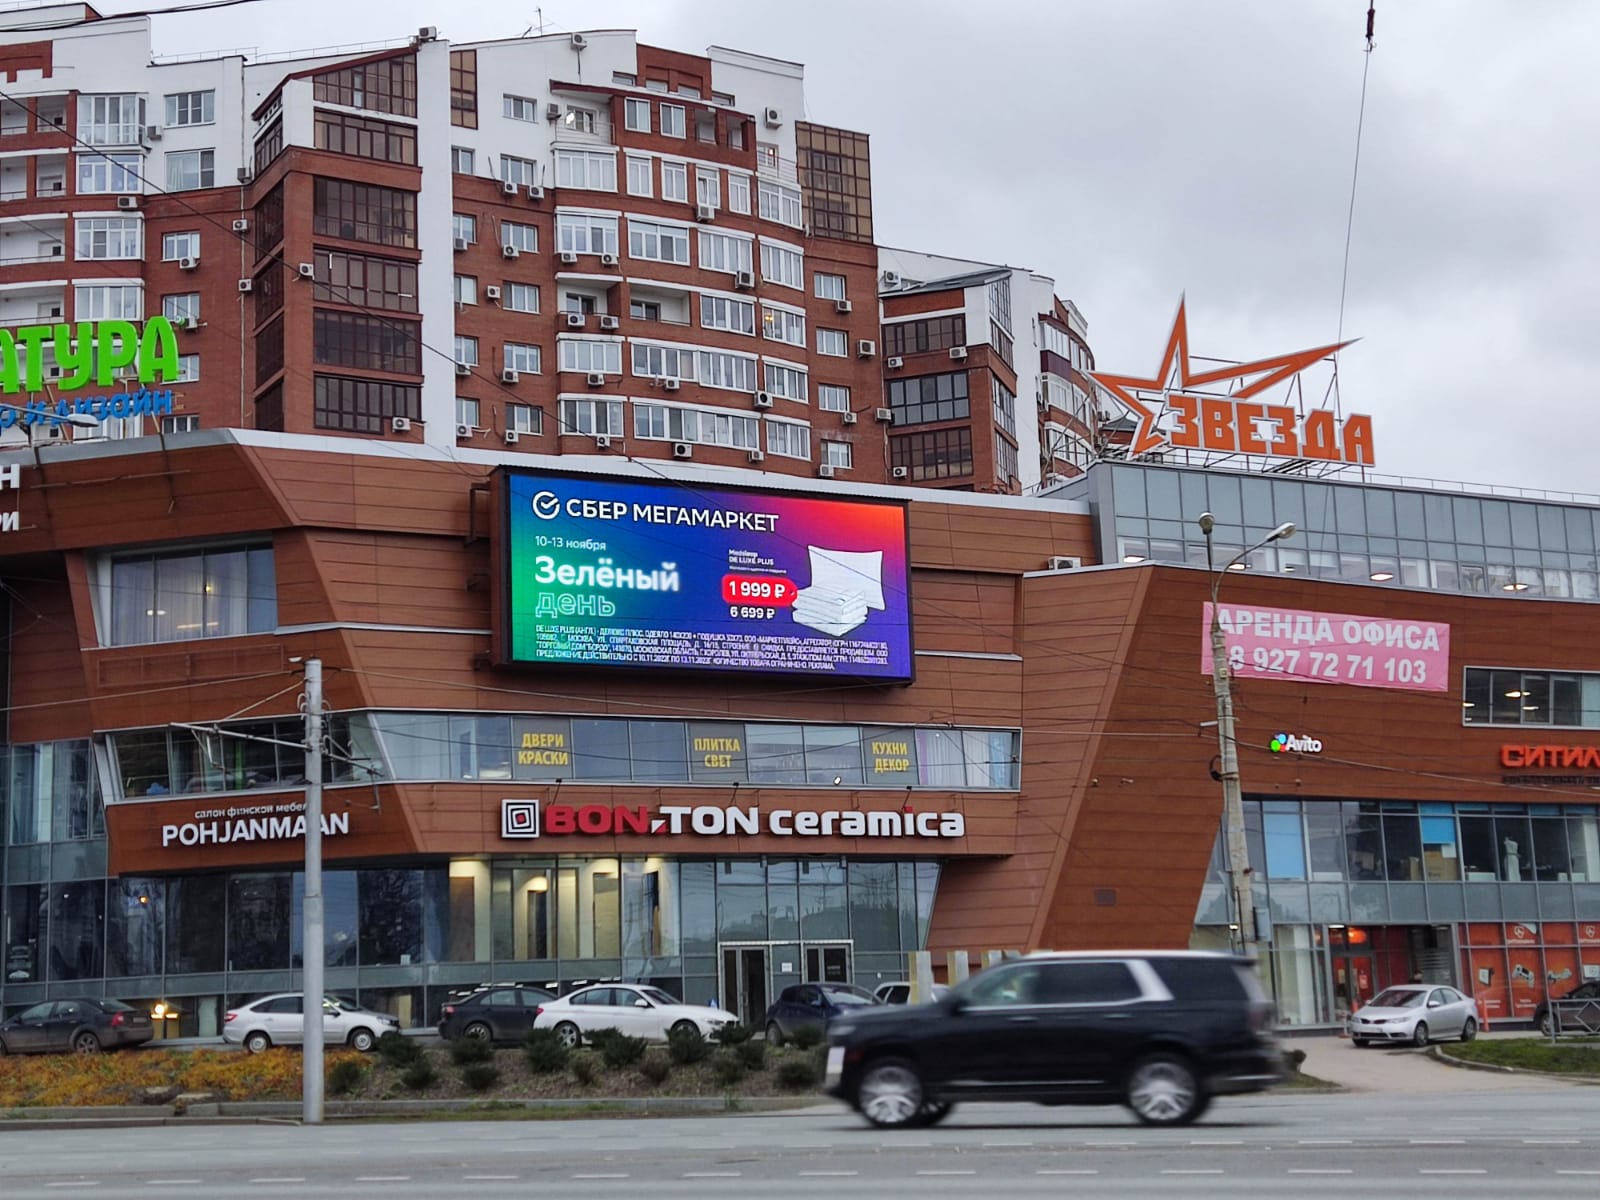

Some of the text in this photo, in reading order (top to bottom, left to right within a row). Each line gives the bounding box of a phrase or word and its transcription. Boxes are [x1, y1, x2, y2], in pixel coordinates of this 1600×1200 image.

[1165, 394, 1375, 467] ЗВЕЗДА
[0, 511, 19, 532] и
[566, 498, 779, 532] СБЕР МЕГАМАРКЕТ
[535, 535, 606, 551] 10-13 ноября
[739, 556, 756, 565] LUXE
[757, 558, 774, 566] PLUS
[535, 555, 680, 592] Зелёный
[729, 580, 736, 596] 1
[740, 581, 771, 598] 999
[535, 592, 616, 618] день
[730, 606, 738, 617] 6
[741, 607, 764, 618] 699
[1218, 608, 1440, 651] АРЕНДА ОФИСА
[1229, 645, 1427, 683] 8 927 72 71 103
[522, 733, 564, 749] ДВЕРИ
[694, 738, 740, 753] ПЛИТКА
[872, 742, 908, 756] КУХНИ
[1285, 734, 1322, 752] Avito
[518, 751, 568, 766] КРАСКИ
[704, 754, 732, 768] СВЕТ
[874, 758, 910, 774] ДЕКОР
[194, 807, 226, 819] салон
[276, 802, 307, 812] мебе
[769, 805, 966, 837] ceramica
